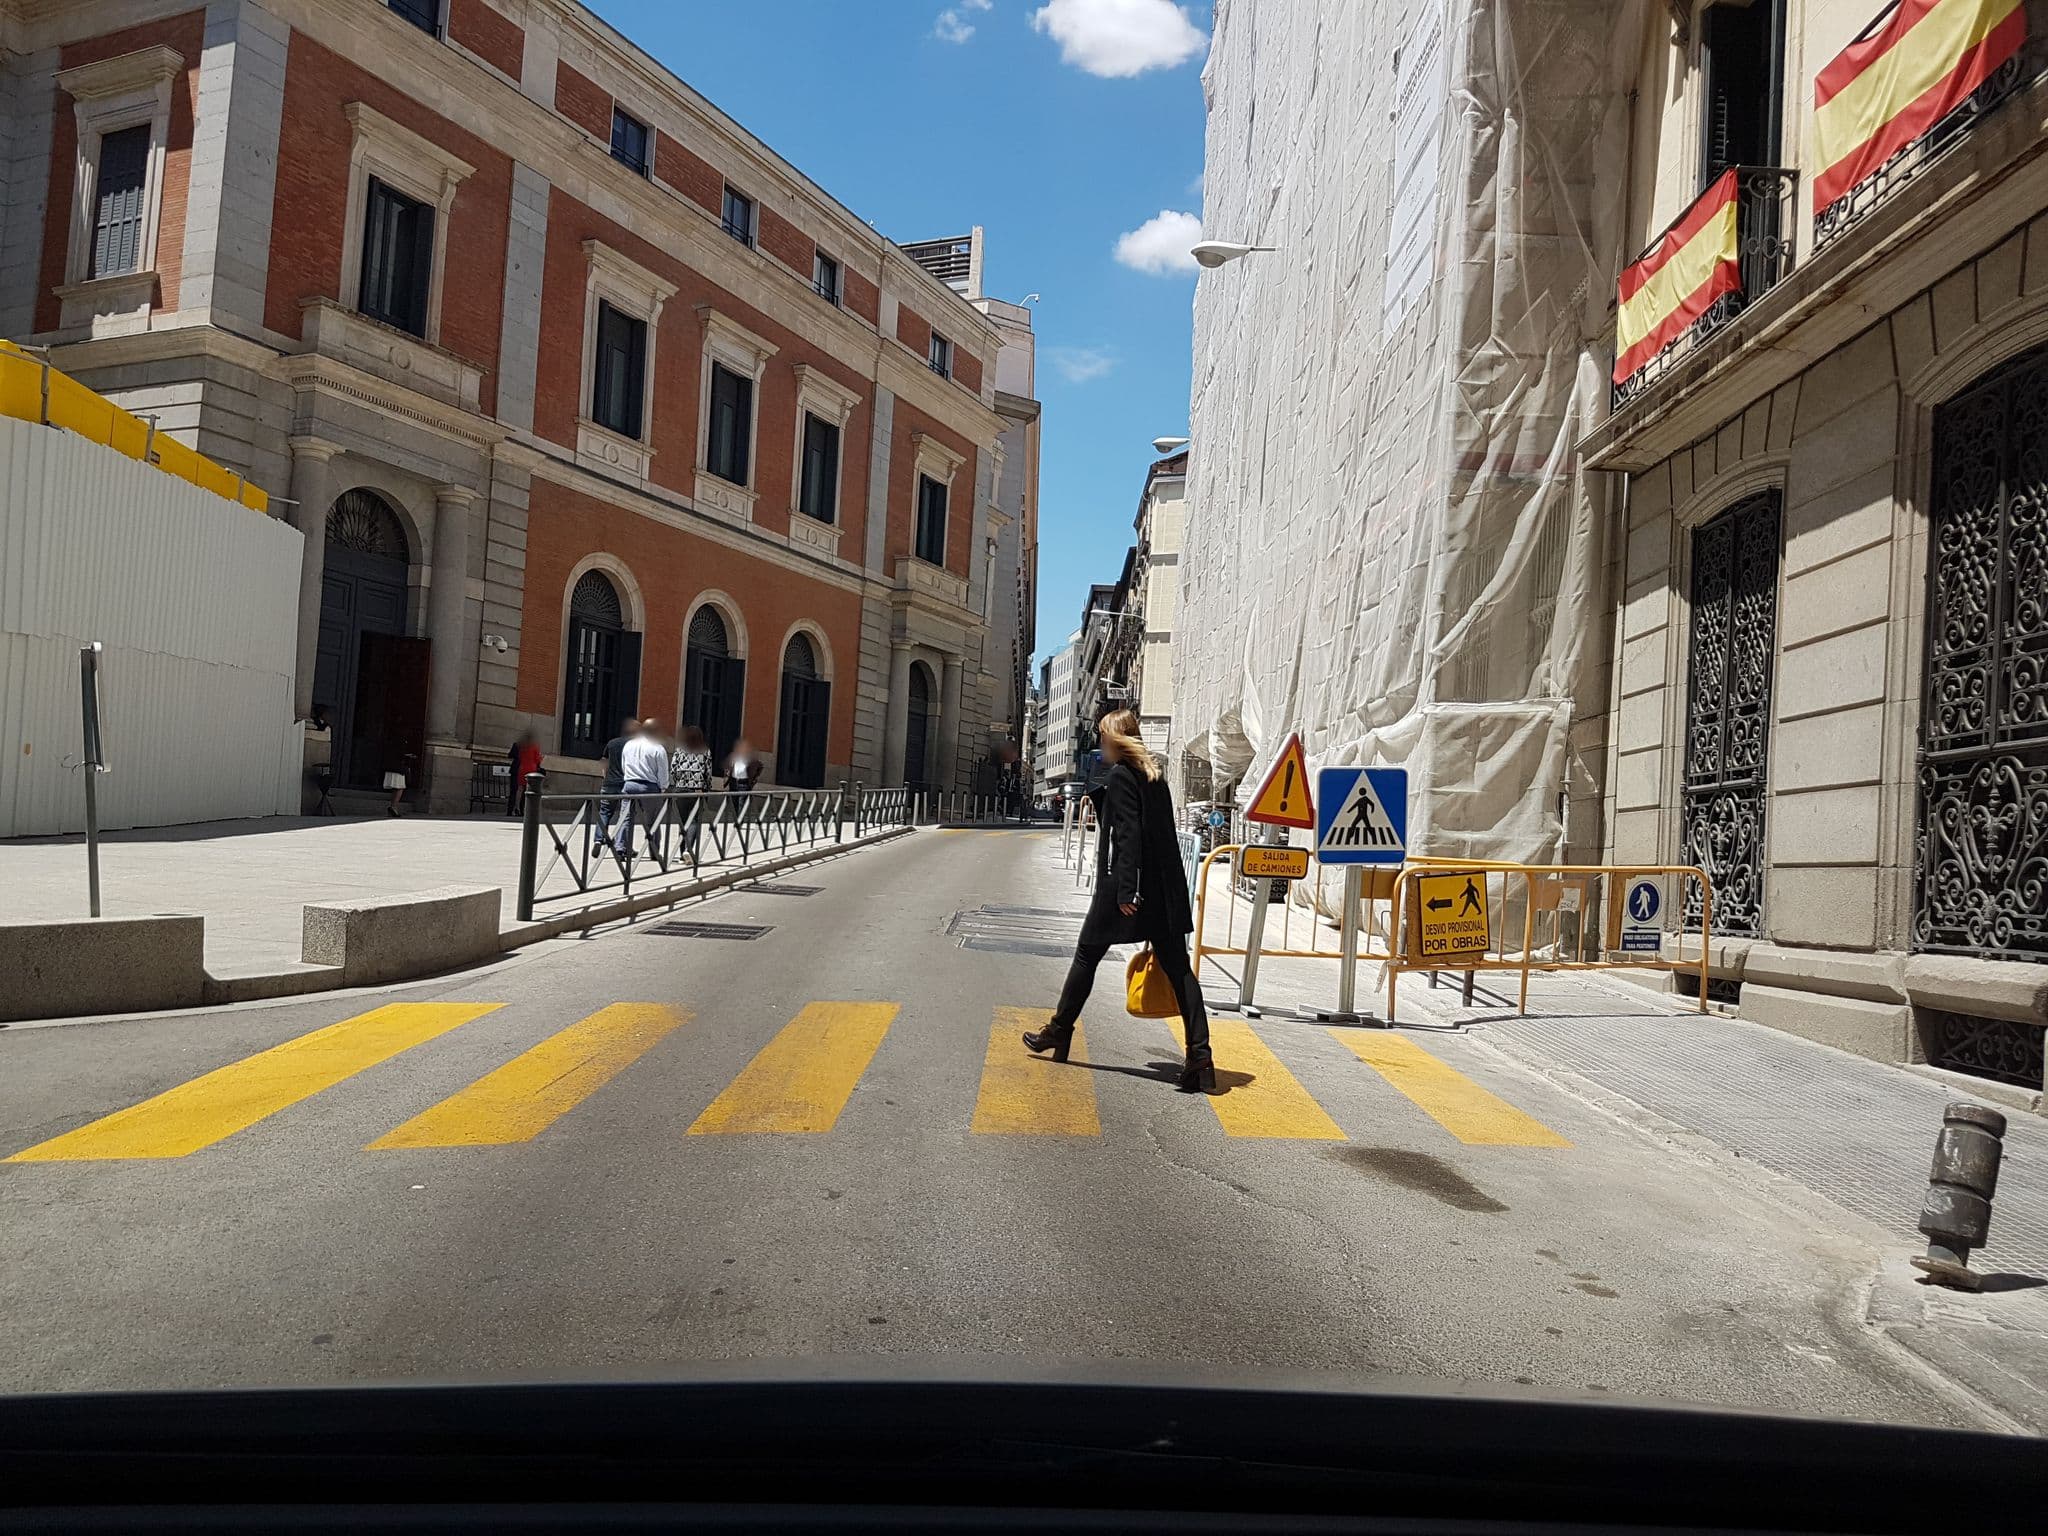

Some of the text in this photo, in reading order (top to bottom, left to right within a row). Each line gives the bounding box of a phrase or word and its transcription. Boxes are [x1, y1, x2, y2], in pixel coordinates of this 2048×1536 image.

[1262, 851, 1290, 861] SALIDA
[1247, 863, 1302, 874] DE CAMIONES
[1426, 920, 1484, 935] DESVIO PROVISIONAL
[1425, 935, 1487, 951] POR OBRAS
